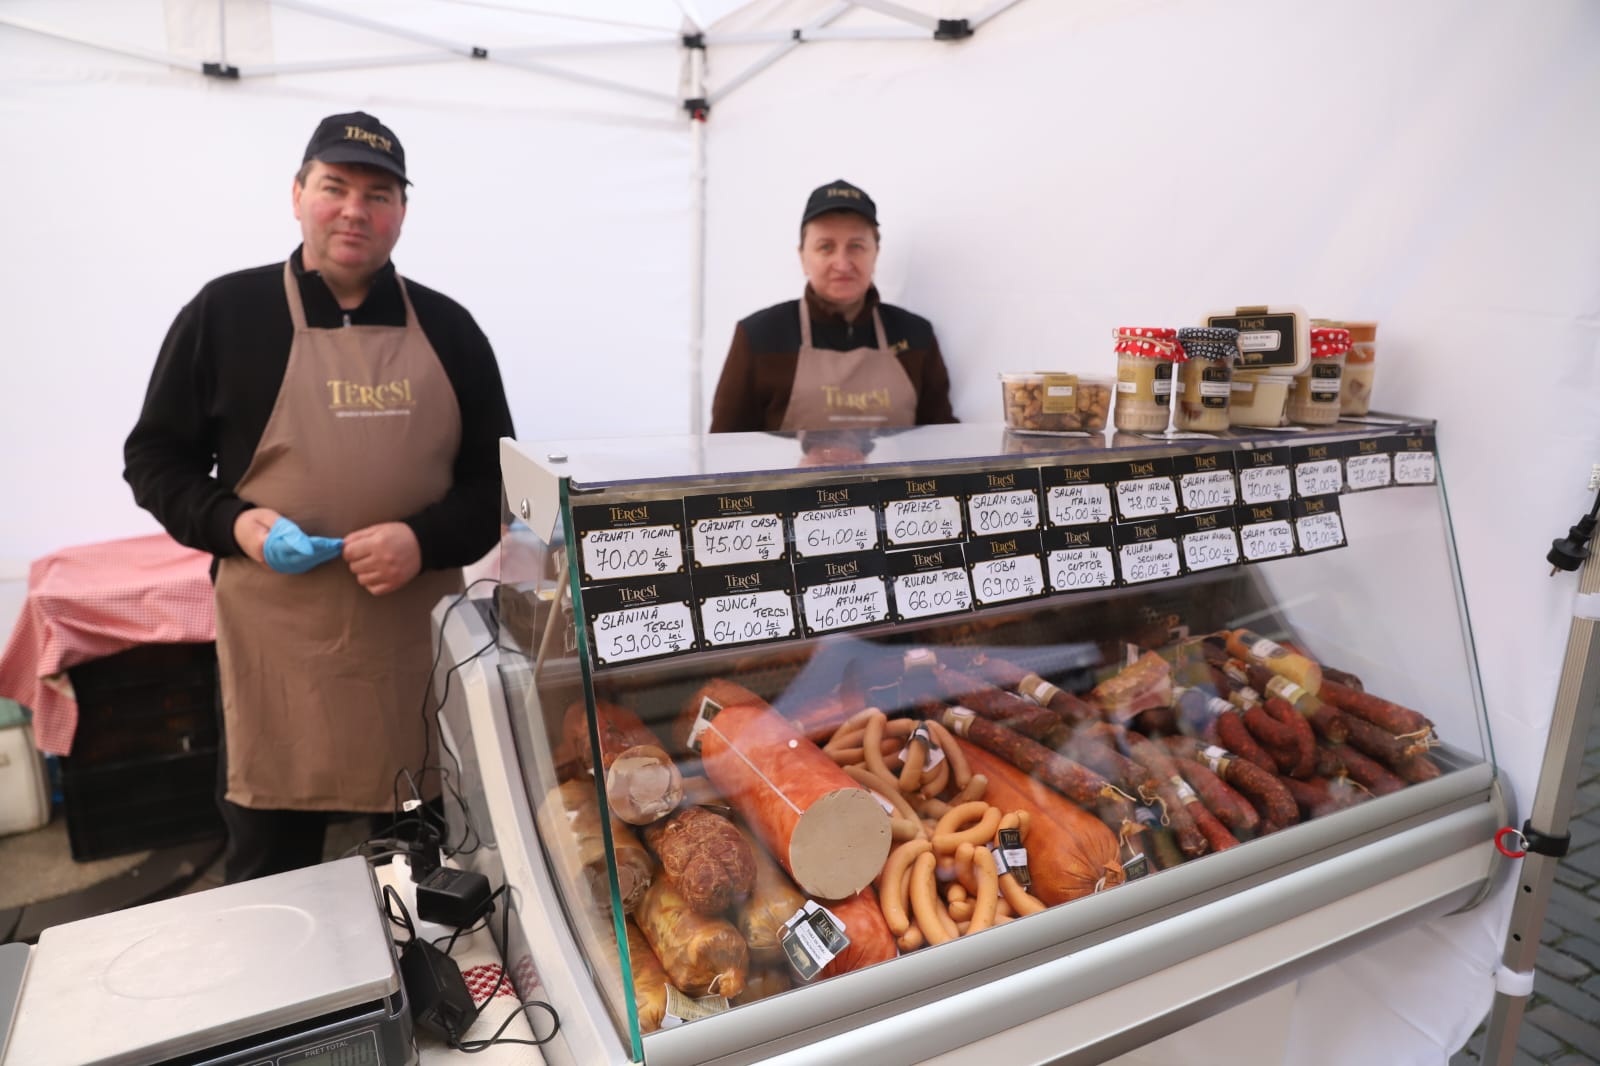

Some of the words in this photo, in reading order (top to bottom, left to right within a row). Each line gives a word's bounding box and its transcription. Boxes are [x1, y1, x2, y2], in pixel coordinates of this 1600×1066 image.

[344, 125, 393, 154] TERCSI
[327, 379, 416, 409] TERCSI
[821, 386, 891, 412] TERCSI
[1129, 462, 1155, 474] TERCSI
[1194, 456, 1216, 467] TERCSI
[987, 474, 1015, 487] TERCSI
[1064, 468, 1091, 480] TERCSI
[906, 480, 937, 494] TERCSI
[1120, 483, 1143, 494] SALAM
[1183, 477, 1205, 488] SALAM
[816, 489, 850, 503] TERCSI
[1054, 488, 1082, 498] SALAM
[1189, 489, 1219, 509] 80,00
[718, 496, 754, 511] TERCSI
[894, 500, 942, 516] PARIZER
[974, 495, 1007, 508] SALAM
[1072, 497, 1102, 505] ITALIAN
[1128, 496, 1157, 511] 78,00
[609, 506, 649, 522] TERCSI
[980, 510, 1018, 530] 80,00
[1056, 506, 1088, 522] 45,00
[1195, 515, 1216, 527] TERCSI
[751, 519, 778, 528] CASA
[894, 521, 938, 538] 60,00
[640, 529, 675, 539] PICANT
[808, 529, 853, 547] 64,00
[1065, 531, 1091, 544] TERCSI
[1135, 525, 1158, 538] TERCSI
[1243, 528, 1264, 539] SALAM
[705, 535, 752, 555] 75,00
[990, 539, 1017, 553] TERCSI
[1250, 540, 1276, 557] 80,00
[596, 548, 648, 571] 70,00
[912, 552, 943, 566] TERCSI
[1189, 546, 1221, 564] 95,00
[825, 560, 859, 576] TERCSI
[987, 560, 1015, 574] TOBA
[1068, 562, 1102, 570] CUPTOR
[1130, 564, 1158, 579] 66,00
[725, 573, 761, 587] TERCSI
[902, 574, 938, 588] RULADA
[942, 572, 965, 581] PORC
[1056, 570, 1093, 588] 60,00
[619, 585, 658, 601] TERCSI
[982, 578, 1020, 597] 69,00
[836, 592, 878, 608] AFUMAT
[909, 590, 952, 610] 66,00
[753, 608, 789, 618] TERCSI
[815, 608, 857, 629] 46,00
[643, 620, 684, 633] TERCSI
[713, 621, 761, 642] 64,00
[610, 635, 661, 656] 59,00
